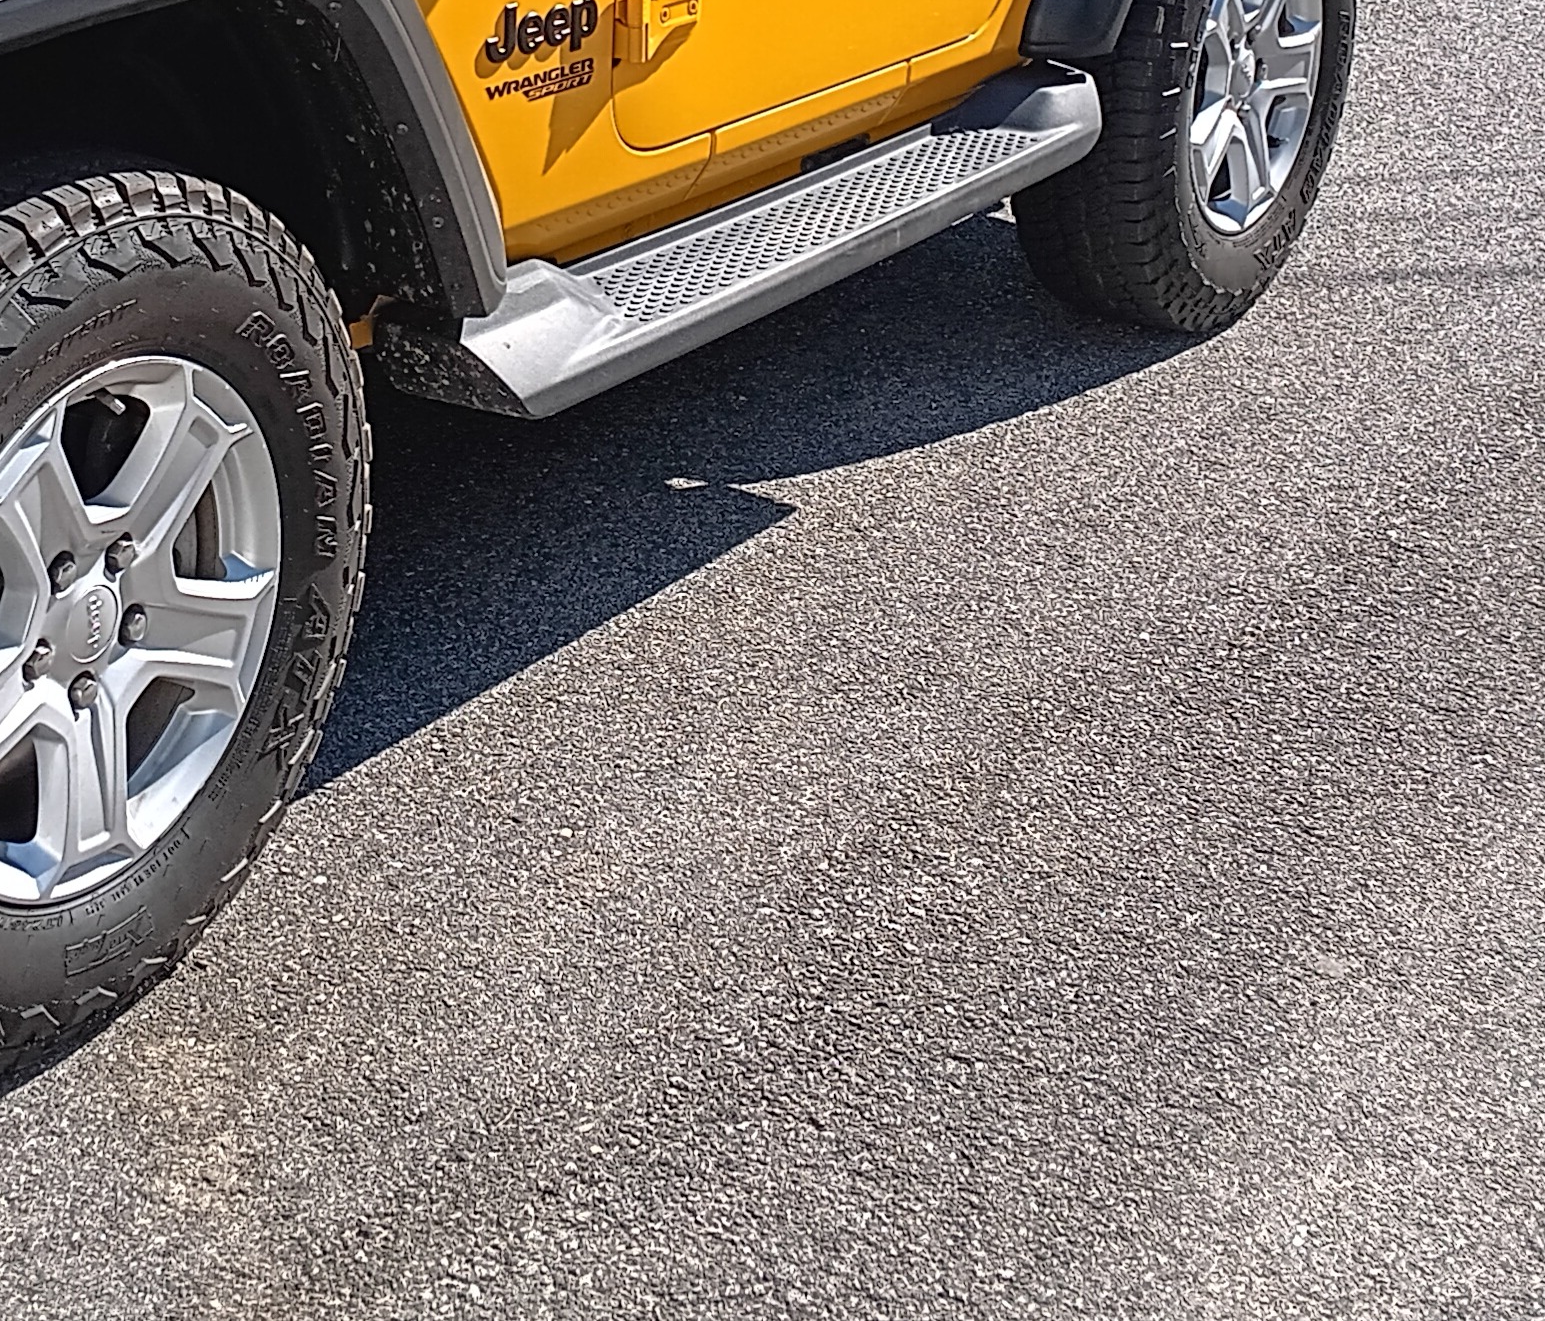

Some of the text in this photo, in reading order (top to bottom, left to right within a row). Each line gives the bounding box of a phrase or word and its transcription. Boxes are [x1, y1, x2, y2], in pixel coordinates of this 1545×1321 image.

[485, 57, 594, 101] WRANGLER
[525, 74, 593, 100] SPORT
[235, 310, 338, 558] ROADIAN
[258, 582, 332, 764] ATX
